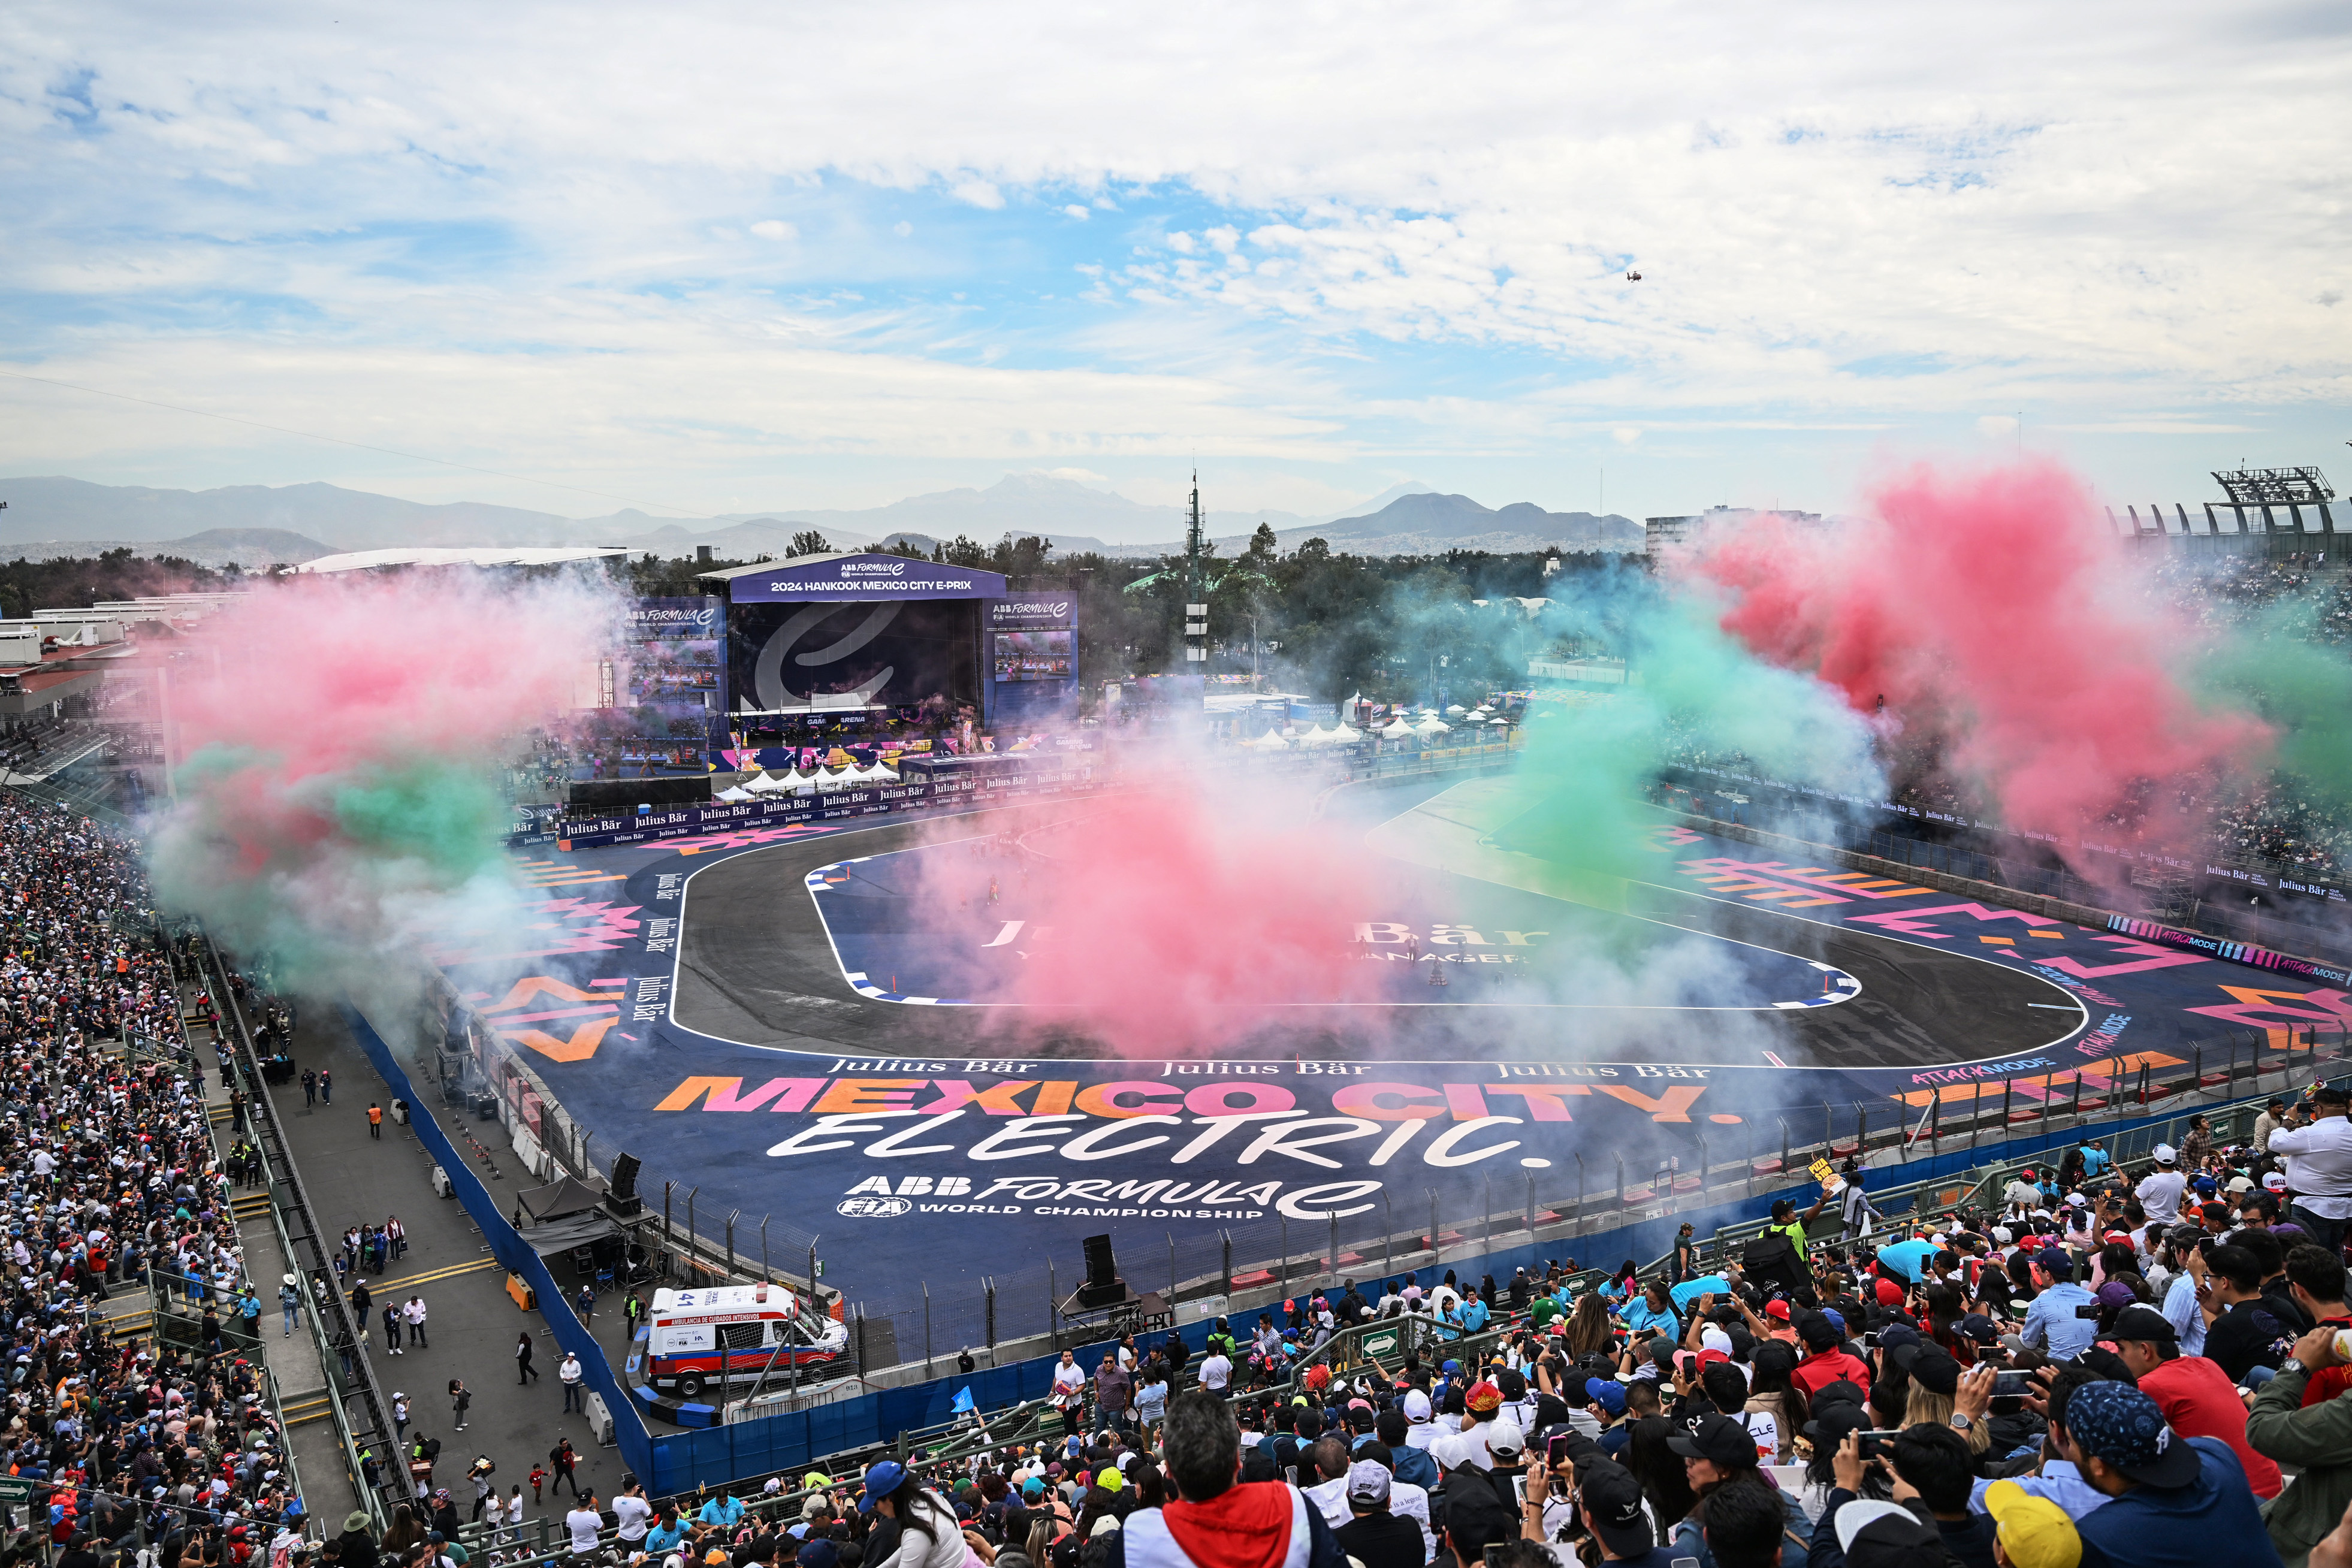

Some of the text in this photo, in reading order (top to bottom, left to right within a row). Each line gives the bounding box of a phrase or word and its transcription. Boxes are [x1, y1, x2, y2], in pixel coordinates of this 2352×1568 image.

[857, 563, 892, 572] FORMULA
[771, 581, 971, 591] 2024 HANKOOK MEXICO CITY E-PRIX
[624, 611, 645, 620] ABB
[647, 609, 698, 621] FORMULA
[993, 605, 1012, 613] ABB
[1012, 603, 1055, 614] FORMULA
[1288, 753, 1307, 762] Julius
[1327, 750, 1345, 759] Julius
[1801, 785, 1815, 794] Julius
[512, 772, 1076, 836] Bär Julius Bär Julius Bär Julius Bär Julius Bär Julius Bär Julius Bär Julius Bär Julius Bär Julius Bär
[1839, 793, 1853, 802] Julius
[1881, 801, 1897, 811] Julius
[1926, 810, 1955, 822] Julius Bär
[1974, 819, 1992, 829] Julius
[2024, 830, 2044, 840] Julius
[2045, 833, 2058, 842] Bär
[2082, 840, 2102, 851] Julius
[2104, 844, 2118, 854] Bär
[2164, 856, 2179, 866] Bär
[2206, 865, 2250, 880] Julius Bär
[656, 873, 683, 899] Julius Bär
[2278, 878, 2326, 896] Julius Bär
[646, 917, 677, 952] Julius Bär
[1347, 922, 1550, 946] Bär
[1330, 951, 1530, 963] ANAGER
[633, 975, 670, 1021] Julius Bär
[827, 1059, 1038, 1073] Julius Bär
[1161, 1062, 1372, 1077] Julius Bär
[1495, 1064, 1711, 1078] Julius Bär
[653, 1076, 1296, 1119] MEXICO
[1808, 1158, 1828, 1174] PIZZA
[1814, 1166, 1832, 1181] $100
[2270, 1179, 2286, 1187] BULLS
[844, 1176, 971, 1195] ABB
[973, 1176, 1283, 1206] FORMULA
[839, 1197, 1263, 1219] FIA WORLD CHAMPIONSHIP
[677, 1293, 695, 1307] 41
[671, 1318, 701, 1326] AMBULANCIA
[732, 1313, 760, 1321] INTENSIVOS
[1749, 1424, 1774, 1437] CLE
